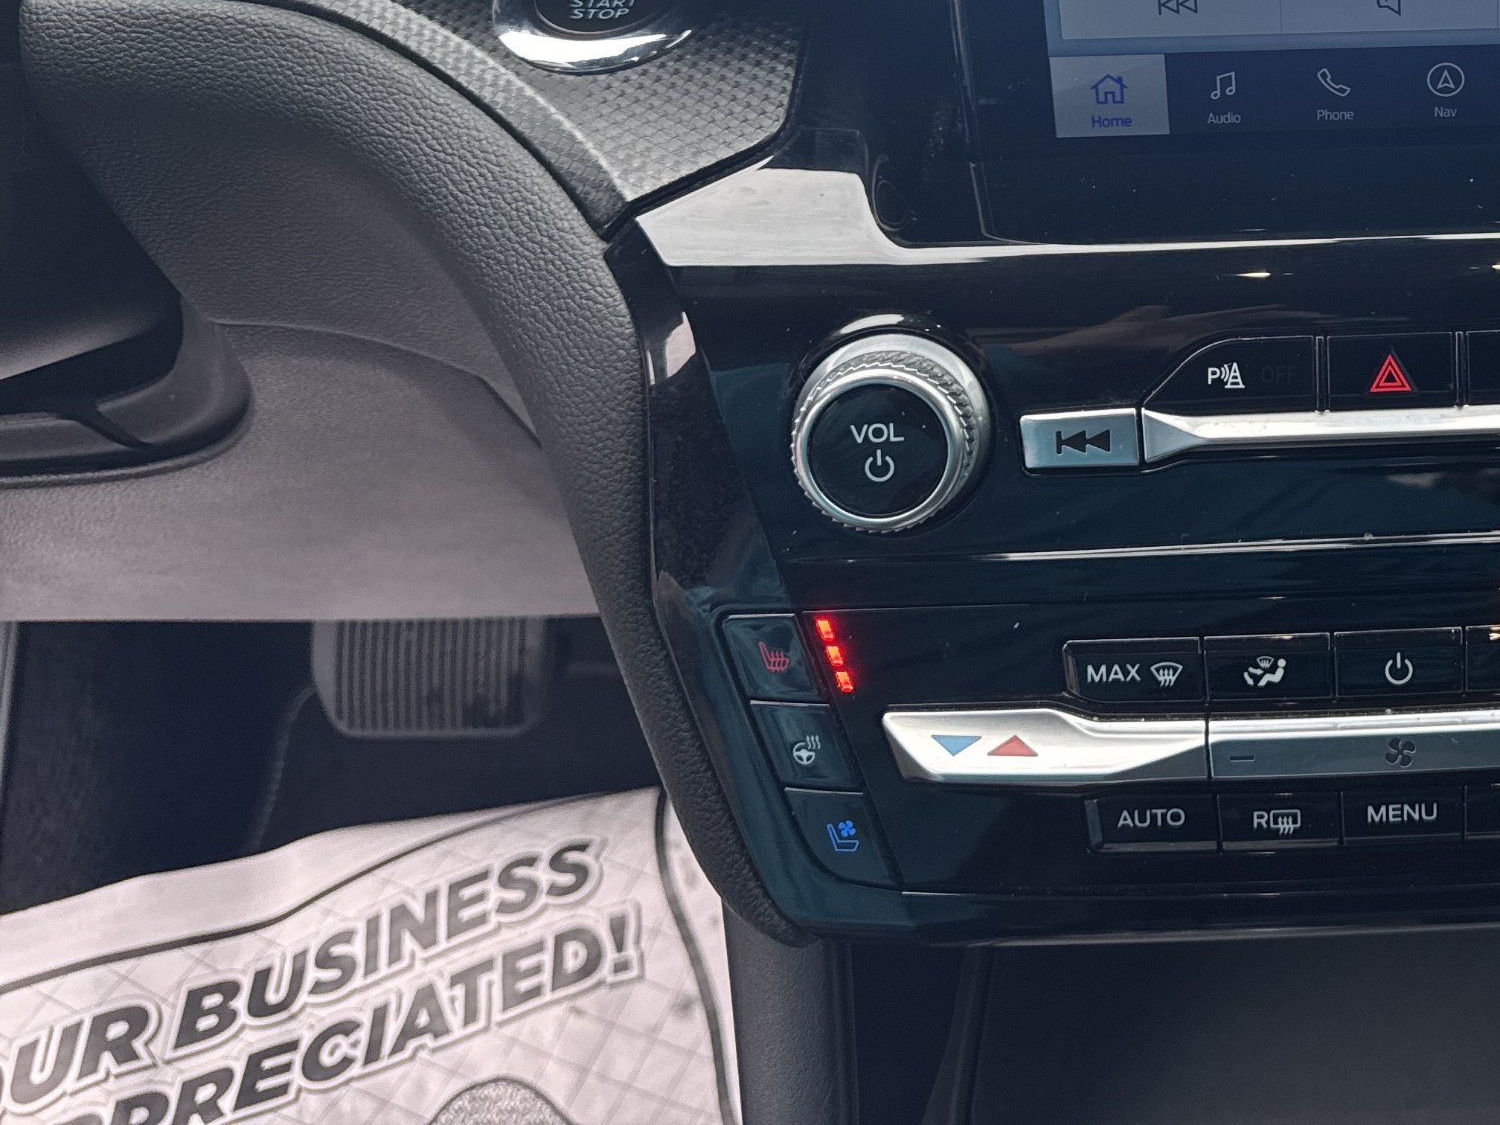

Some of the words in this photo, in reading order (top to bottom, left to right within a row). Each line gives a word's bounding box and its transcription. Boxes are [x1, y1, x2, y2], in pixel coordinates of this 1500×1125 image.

[569, 8, 630, 20] STOP
[1207, 111, 1242, 124] Audio
[1316, 109, 1354, 121] Phone
[1434, 106, 1458, 118] Nav
[1091, 115, 1133, 129] Home
[850, 423, 905, 443] VOL
[1086, 663, 1142, 683] MAX
[1117, 808, 1186, 828] AUTO
[1367, 803, 1438, 823] MENU
[0, 1005, 151, 1105] UR
[173, 839, 595, 1052] BUSINESS
